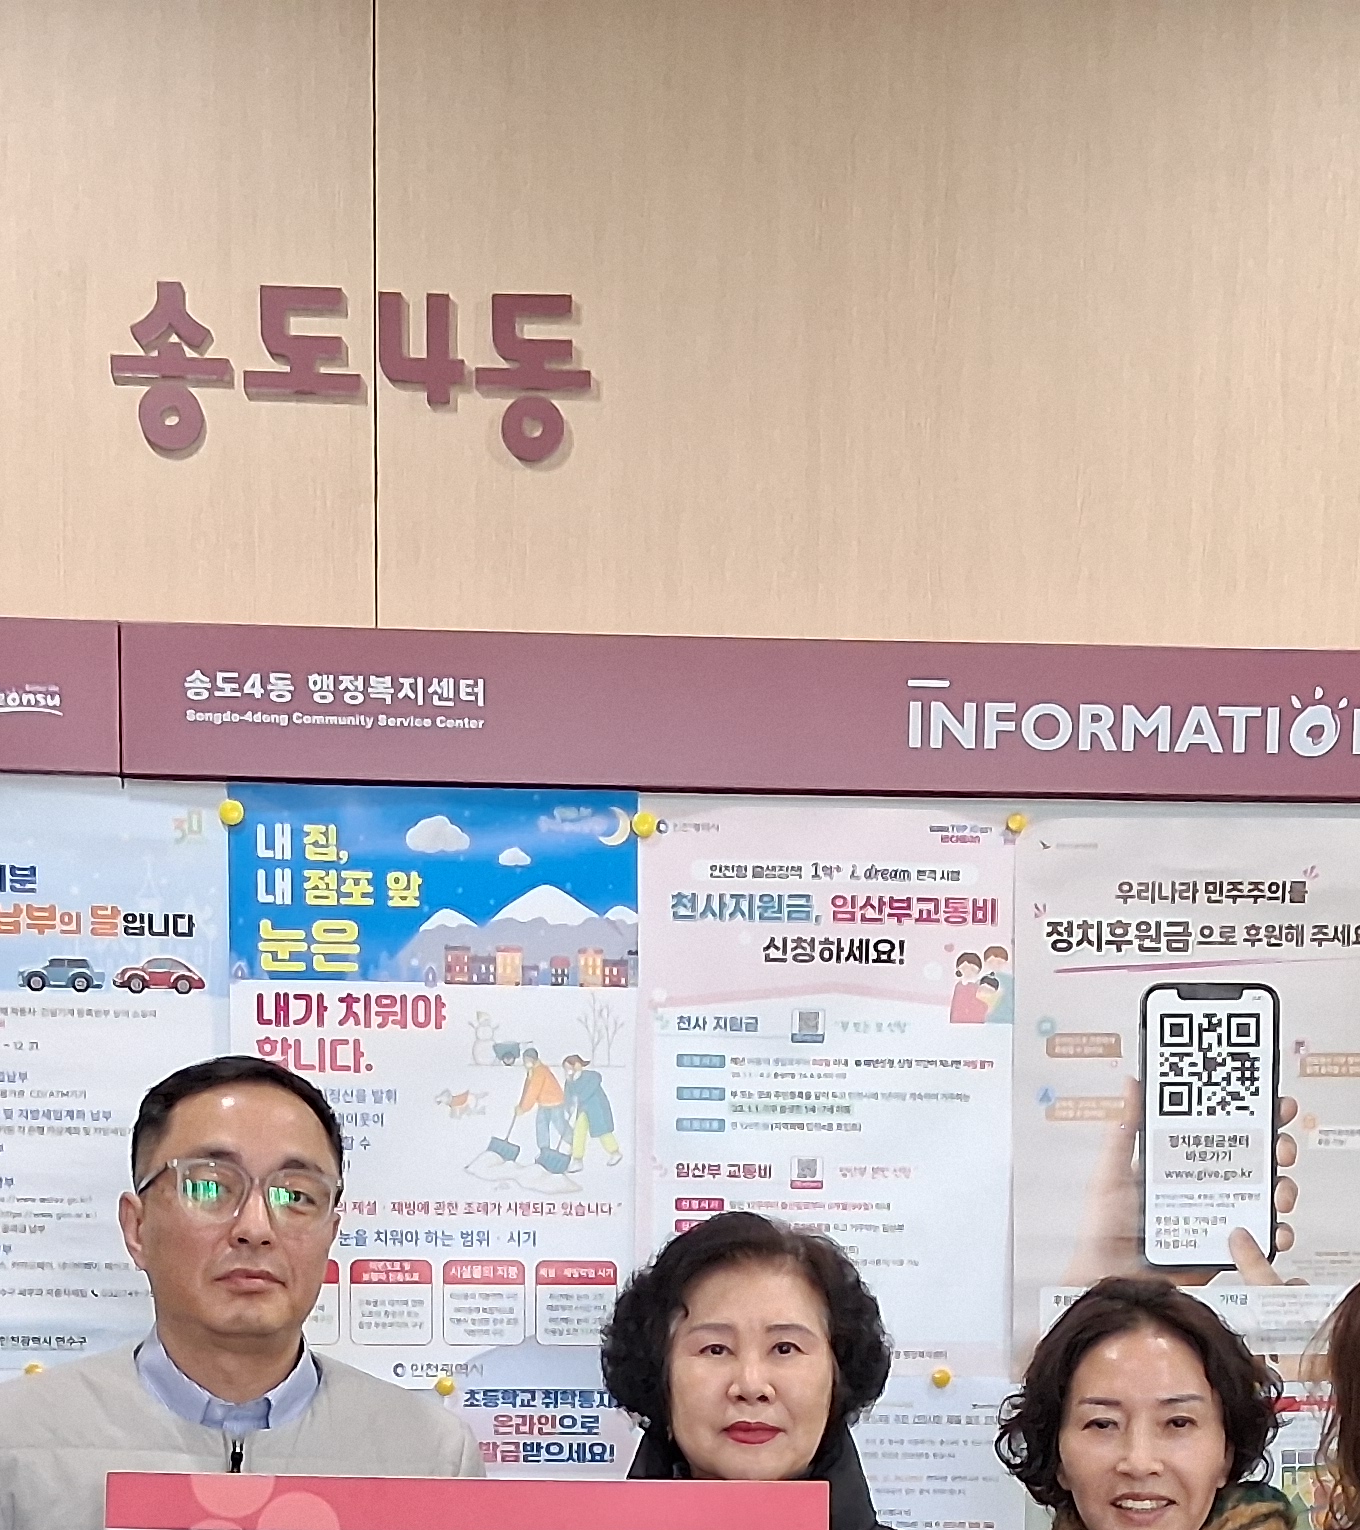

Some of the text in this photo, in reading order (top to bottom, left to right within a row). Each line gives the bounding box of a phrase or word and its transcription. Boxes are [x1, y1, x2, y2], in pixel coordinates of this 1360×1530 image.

[110, 280, 595, 463] 송도4동
[184, 669, 485, 707] 송도4동 행정복지센터
[186, 710, 484, 728] Songdo-4dong Community Service Center
[257, 822, 349, 865] 내 집,
[257, 868, 422, 907] 내 점포 앞
[1116, 880, 1308, 904] 우리나라 민주주의를
[90, 905, 195, 937] 달입니다
[671, 892, 998, 925] 천사지원금, 임산부교통비
[258, 919, 360, 972] 눈은
[763, 937, 906, 965] 신청하세요!
[1243, 925, 1304, 947] 후원해
[257, 993, 446, 1030] 내가 치워야
[256, 1037, 374, 1073] 합니다.
[676, 1163, 721, 1179] 임산부
[339, 1230, 367, 1246] 눈을
[374, 1231, 419, 1246] 치워야
[425, 1231, 454, 1246] 하는
[507, 1231, 536, 1246] 시기
[411, 1363, 483, 1378] 인천광역시
[464, 1390, 536, 1408] 초등학교
[494, 1415, 600, 1436] 온라인으로
